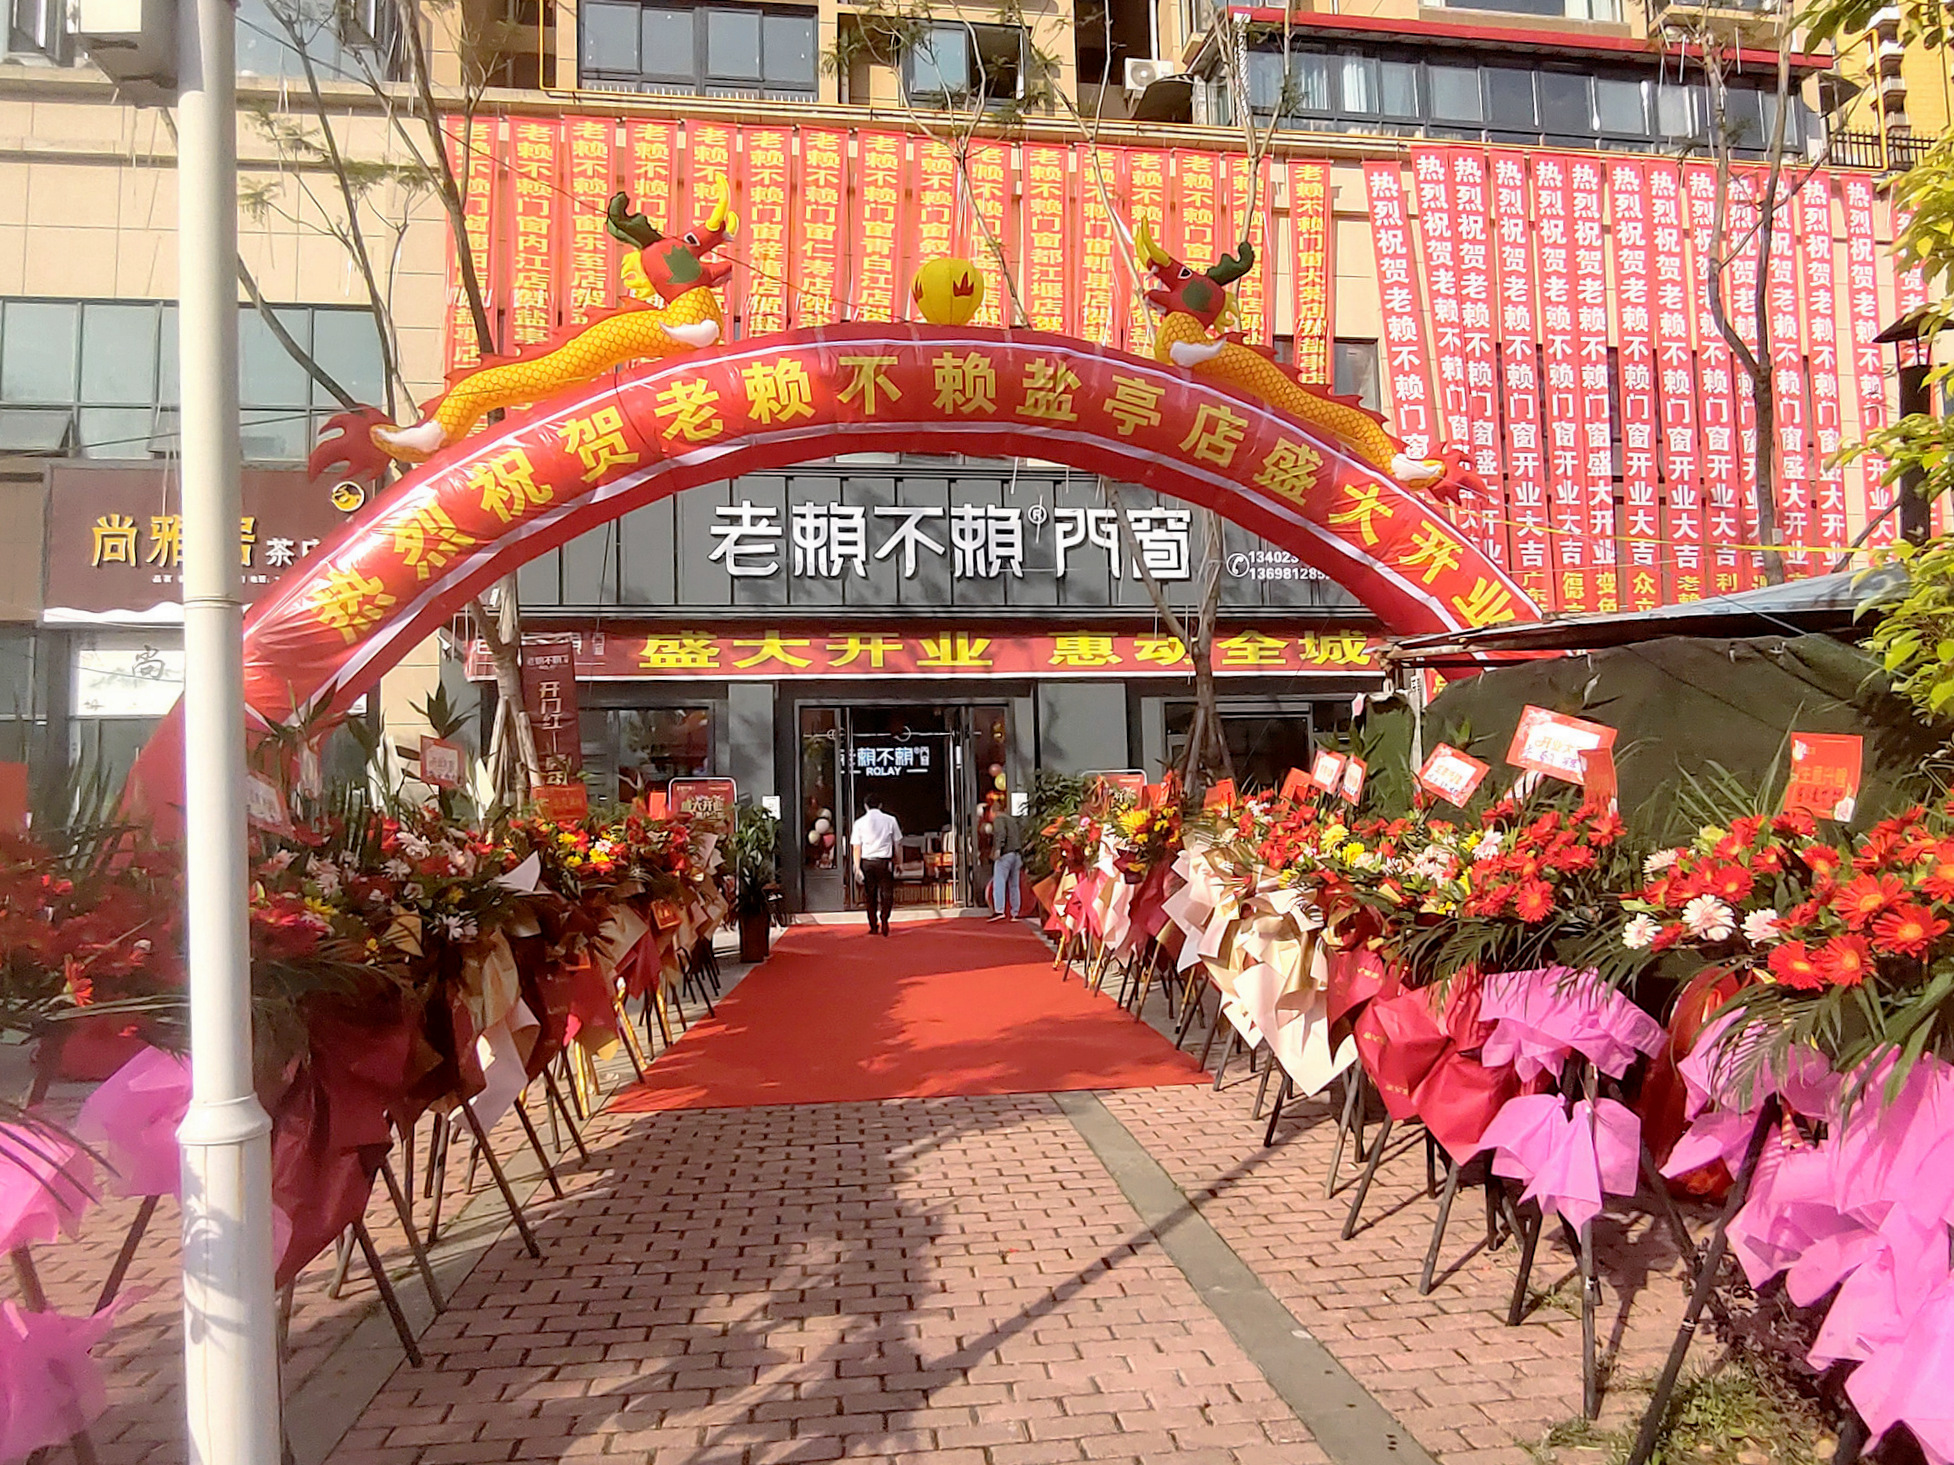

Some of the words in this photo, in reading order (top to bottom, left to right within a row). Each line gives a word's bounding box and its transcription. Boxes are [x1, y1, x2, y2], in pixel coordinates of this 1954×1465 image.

[570, 121, 608, 326] 老赖不赖门窗乐至店贺
[1495, 159, 1546, 568] 热烈祝贺老赖不赖门窗开业大吉
[1535, 160, 1584, 567] 热烈祝贺老赖不赖门窗开业大吉
[1571, 163, 1616, 566] 热烈祝贺老赖不赖门窗盛大开业
[1611, 166, 1656, 567] 热烈祝贺老赖不赖门窗开业大吉
[1649, 170, 1700, 569] 热烈祝贺老赖不赖门窗开业大吉
[305, 350, 1517, 646] 热烈祝贺老赖不赖盐亭店盛大开业
[638, 629, 994, 668] 盛大开业
[1048, 629, 1371, 668] 惠动全城
[1249, 567, 1331, 581] 136981285
[865, 766, 902, 777] ROLAY
